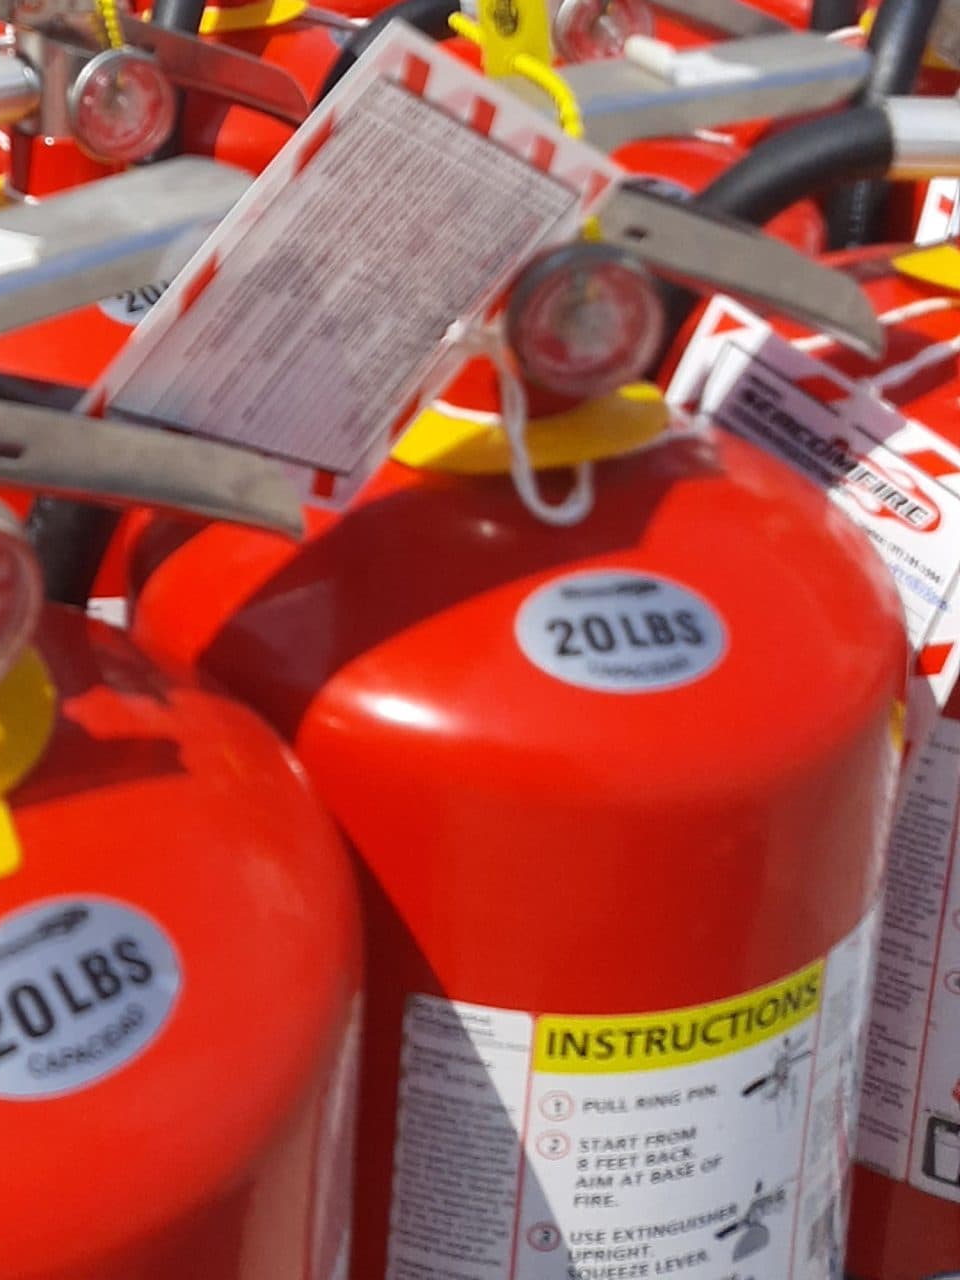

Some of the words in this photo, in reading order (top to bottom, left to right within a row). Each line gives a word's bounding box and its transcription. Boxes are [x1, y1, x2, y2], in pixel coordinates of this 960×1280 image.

[547, 615, 616, 656] 20
[618, 610, 704, 648] LBS
[49, 933, 153, 1015] LBS
[546, 980, 818, 1060] INSTRUCTIONS
[583, 1097, 629, 1113] PULL
[636, 1090, 681, 1109] RING
[579, 1136, 639, 1152] START
[645, 1127, 697, 1146] FROM
[575, 1176, 614, 1189] AIM
[621, 1174, 645, 1187] AT
[649, 1163, 695, 1185] BASE
[596, 1155, 638, 1170] FEET
[569, 1230, 606, 1244] USE
[612, 1203, 738, 1242] EXTINGUISHER
